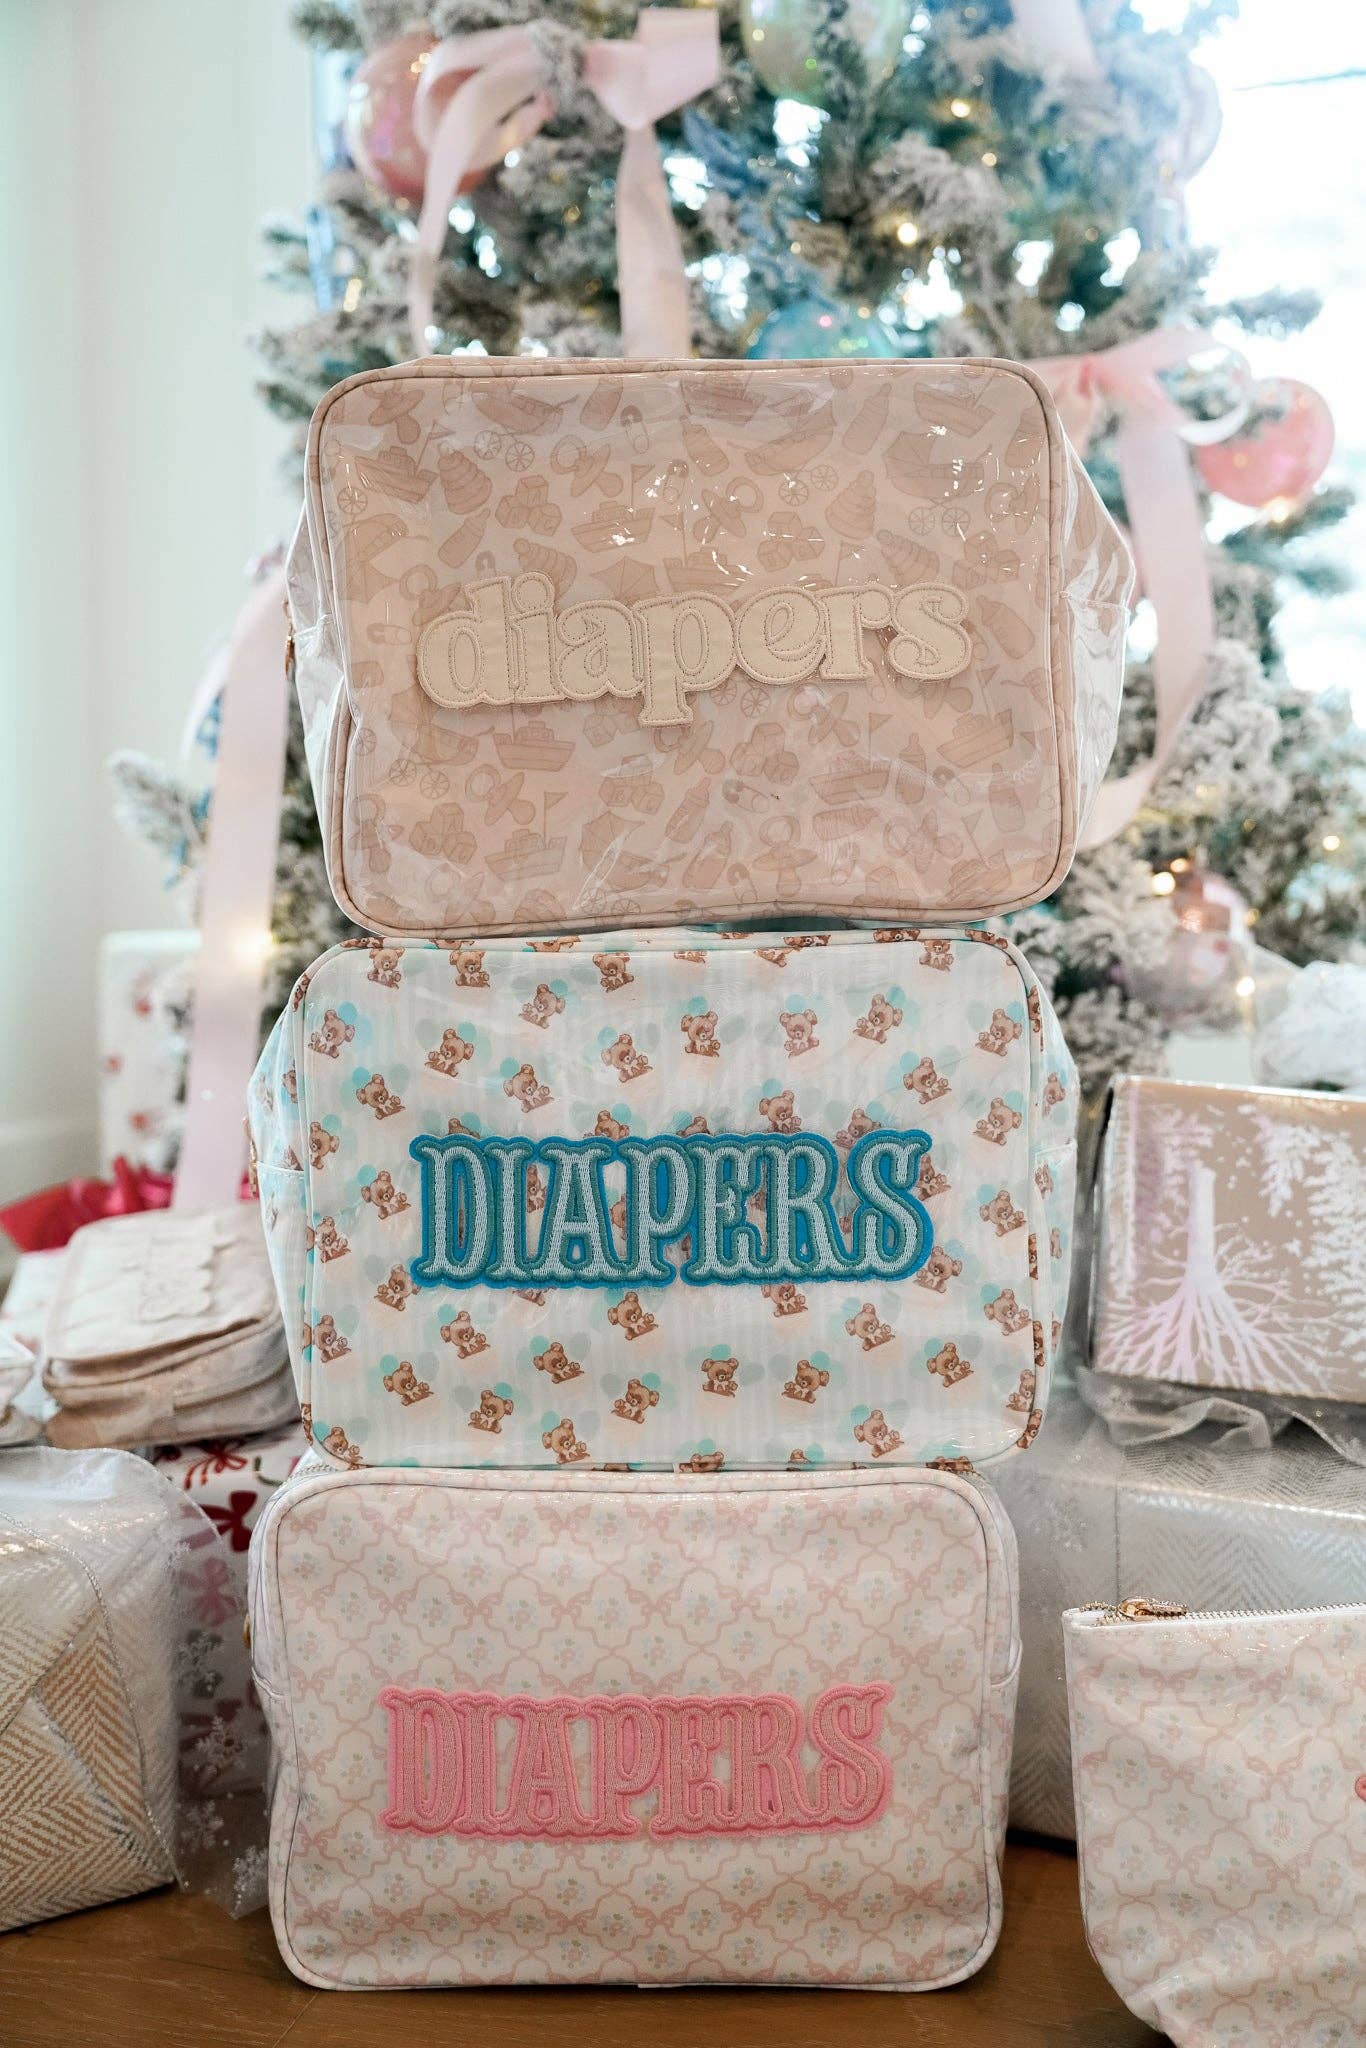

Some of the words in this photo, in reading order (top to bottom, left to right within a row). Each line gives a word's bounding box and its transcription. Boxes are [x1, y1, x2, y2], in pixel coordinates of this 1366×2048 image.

[417, 571, 972, 728] diapers
[410, 1130, 933, 1288] DIAPERS
[379, 1682, 894, 1840] DIAPERS
